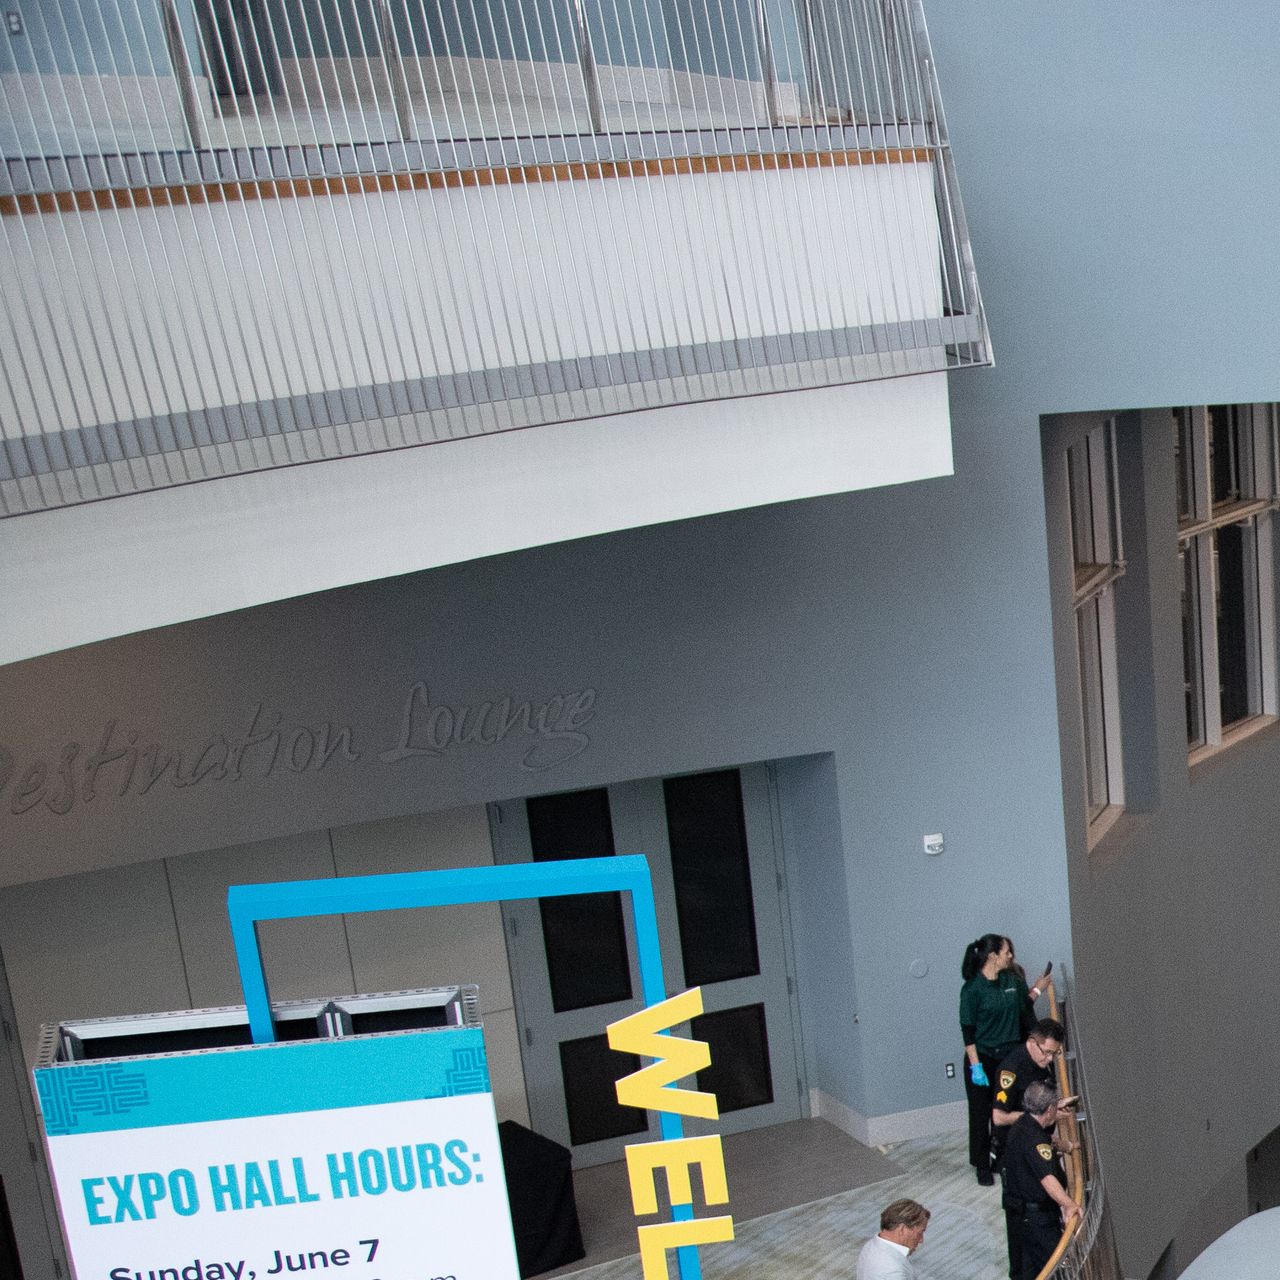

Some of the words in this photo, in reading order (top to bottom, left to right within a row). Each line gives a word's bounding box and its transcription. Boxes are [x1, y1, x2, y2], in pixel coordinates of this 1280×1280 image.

[0, 703, 362, 816] estination
[382, 680, 597, 770] Lounge
[79, 1167, 200, 1227] EXPO
[207, 1156, 320, 1213] HALL
[325, 1138, 484, 1200] HOURS:
[266, 1248, 351, 1275] June
[358, 1238, 380, 1263] 7
